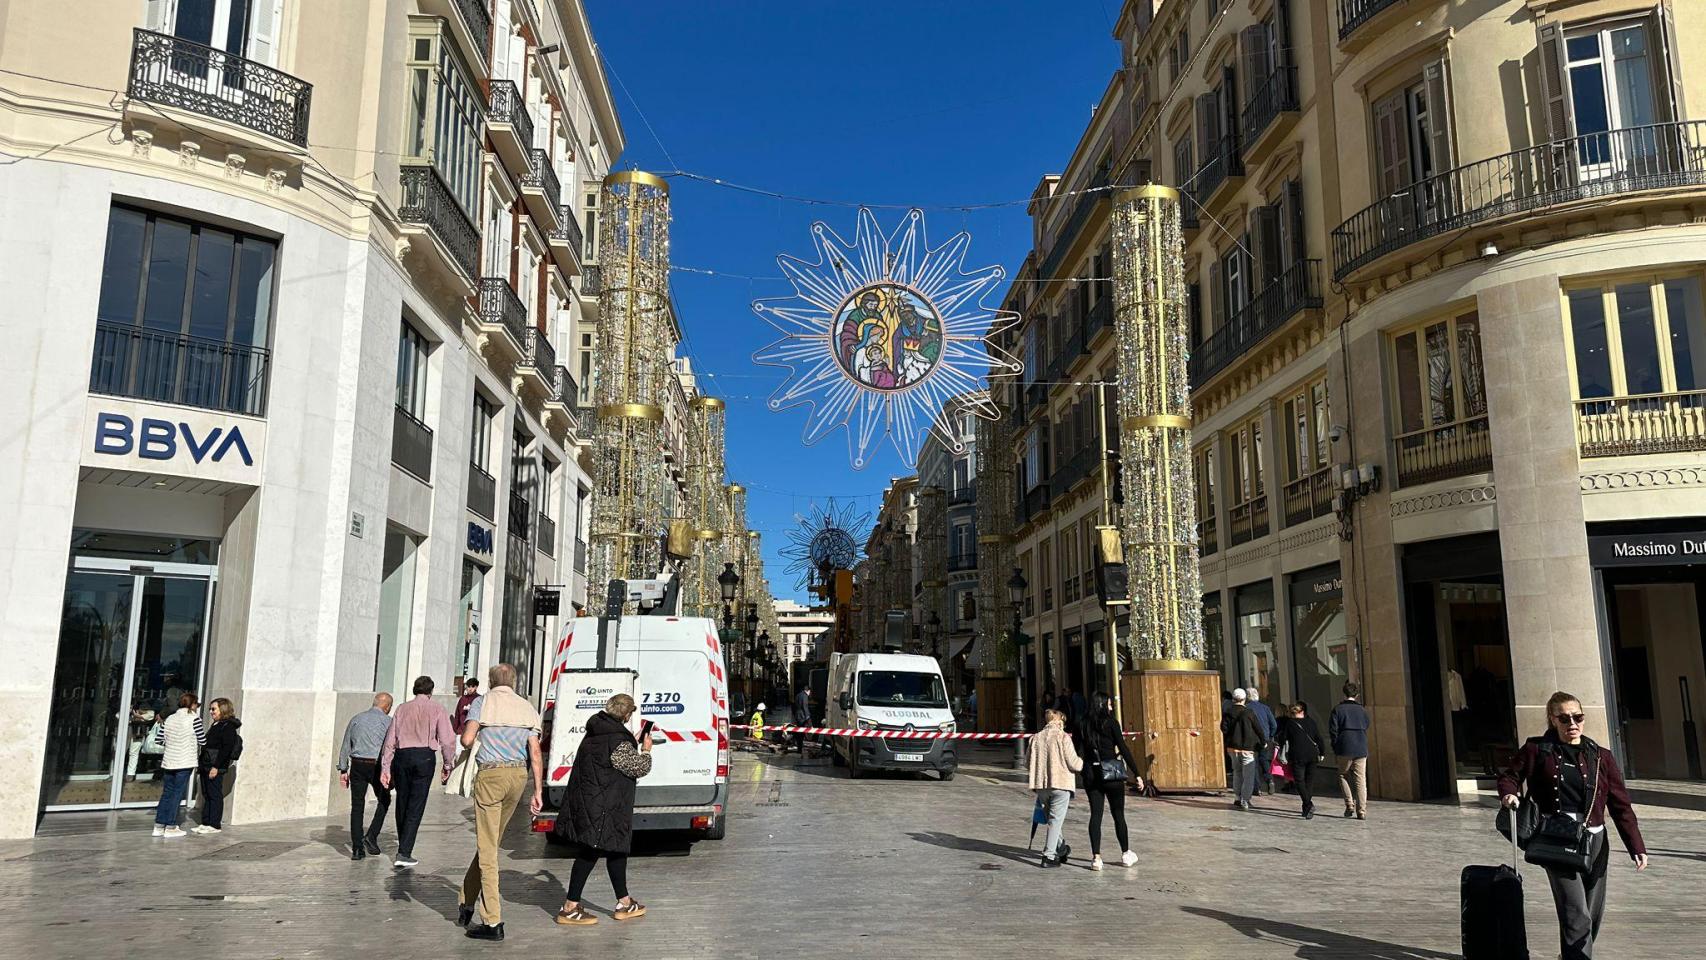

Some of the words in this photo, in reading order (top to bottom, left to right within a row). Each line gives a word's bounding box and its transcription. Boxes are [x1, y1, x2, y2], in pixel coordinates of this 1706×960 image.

[94, 412, 254, 467] BBVA
[467, 521, 493, 557] BBVA
[1614, 541, 1676, 557] Massimo
[654, 692, 681, 703] 370
